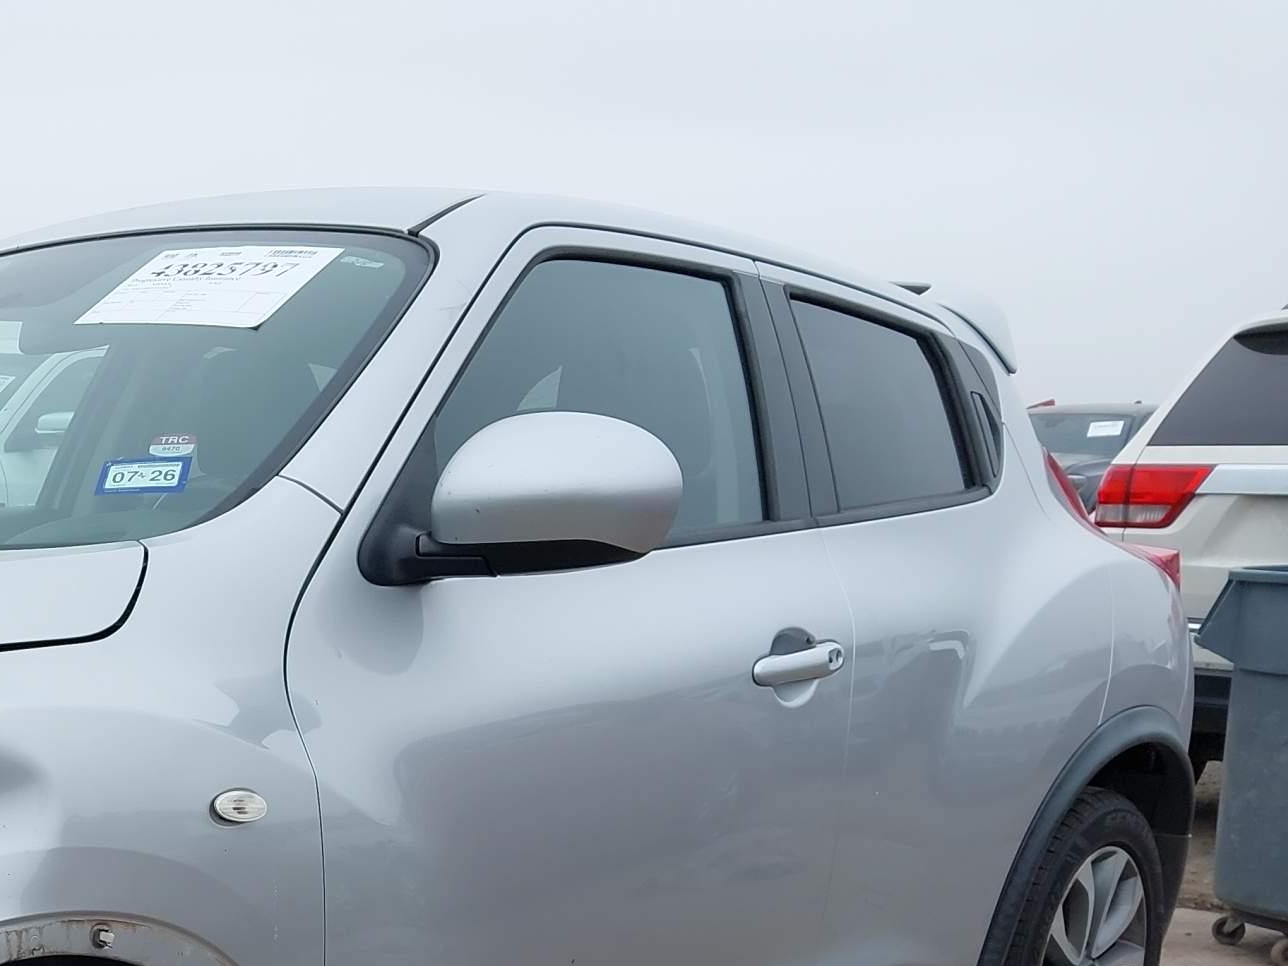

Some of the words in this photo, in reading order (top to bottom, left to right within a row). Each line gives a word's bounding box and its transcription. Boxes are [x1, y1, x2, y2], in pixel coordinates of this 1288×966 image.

[151, 262, 300, 277] 43825797
[112, 471, 139, 484] 07
[149, 469, 177, 482] 26
